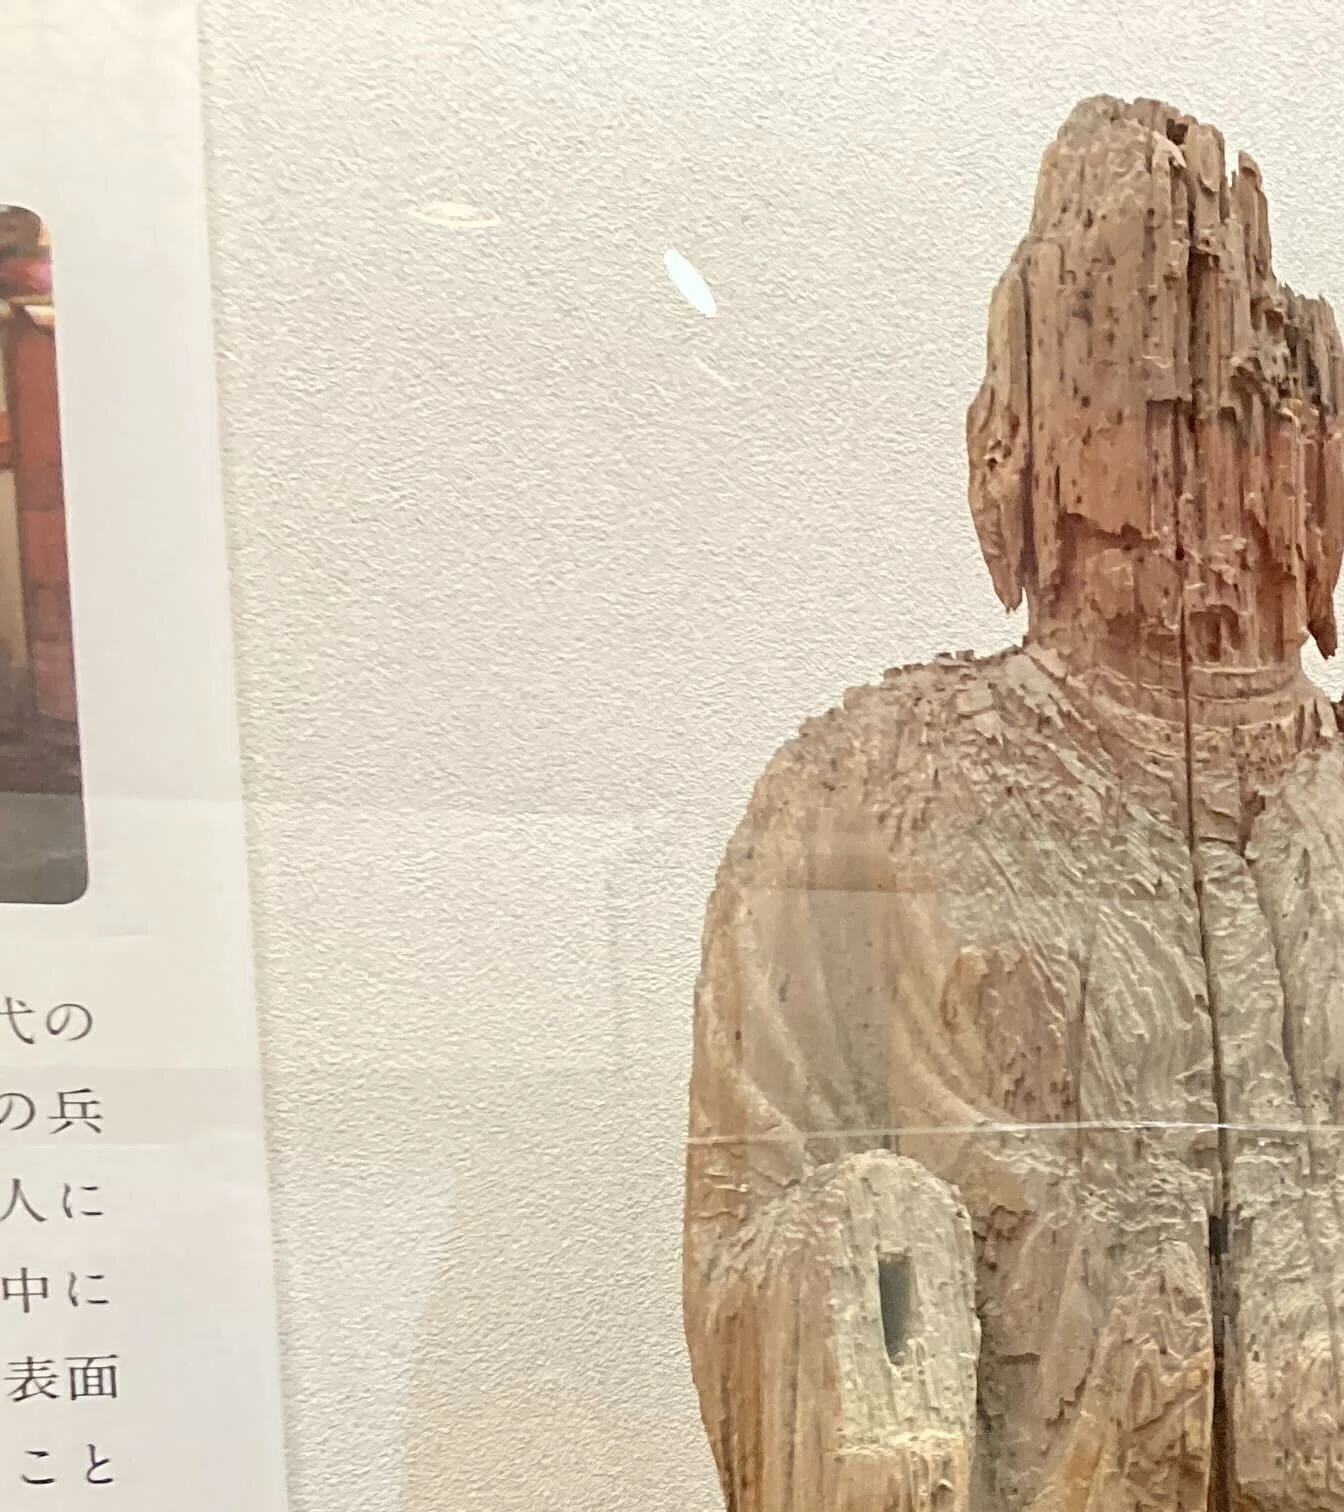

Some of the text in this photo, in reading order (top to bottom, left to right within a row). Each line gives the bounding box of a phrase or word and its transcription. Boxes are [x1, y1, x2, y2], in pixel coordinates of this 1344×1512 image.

[2, 1266, 110, 1313] 中に
[3, 1353, 119, 1401] 表面
[20, 1443, 115, 1485] こと
